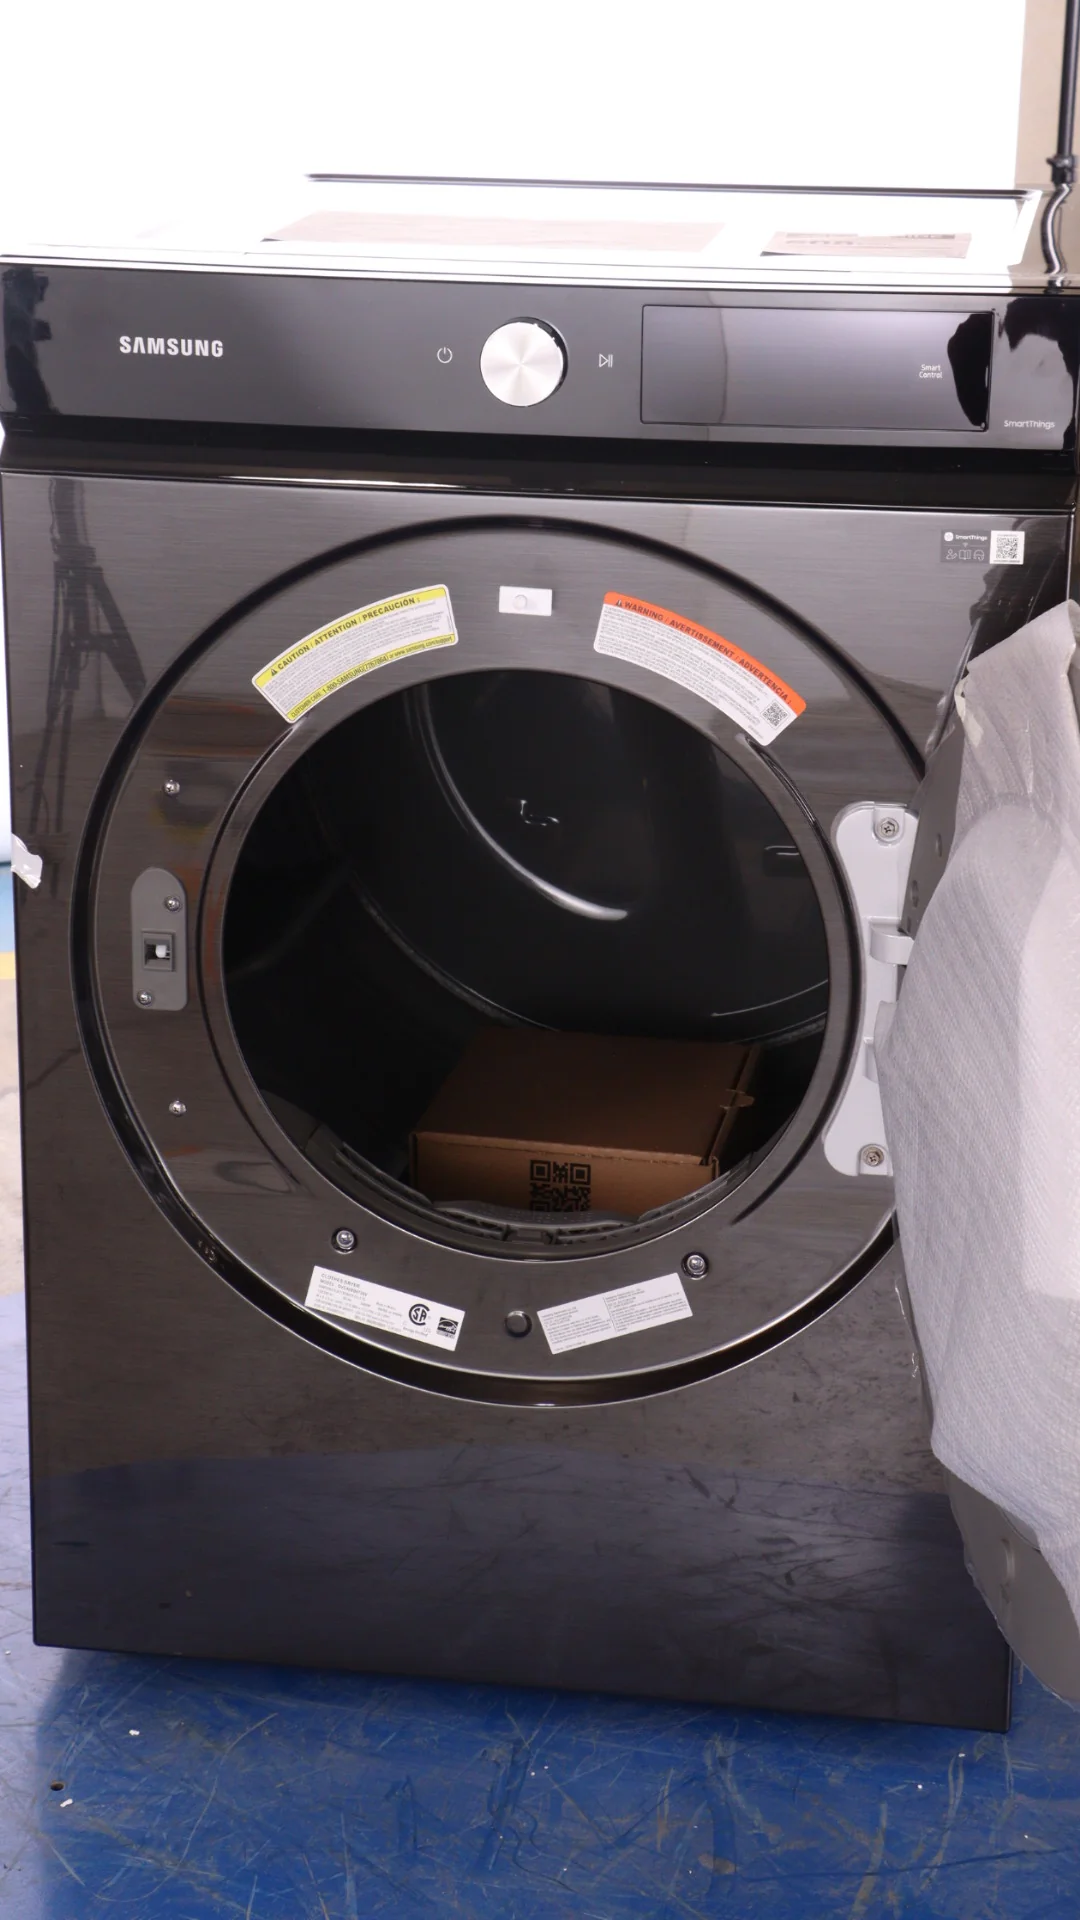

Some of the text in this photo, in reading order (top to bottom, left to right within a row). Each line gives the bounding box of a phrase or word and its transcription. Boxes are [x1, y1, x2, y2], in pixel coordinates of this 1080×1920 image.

[119, 335, 224, 357] SAMSUNG
[919, 371, 943, 379] Control
[1003, 419, 1056, 430] SmartThings
[955, 533, 988, 541] SmartThings
[277, 644, 310, 669] CAUTION
[314, 618, 358, 645] ATTENTION
[362, 597, 416, 621] PRECAUCIÓN
[624, 601, 664, 621] WARNING
[669, 619, 735, 657] AVERTISSEMENT
[739, 658, 789, 701] ADVERTENCIA
